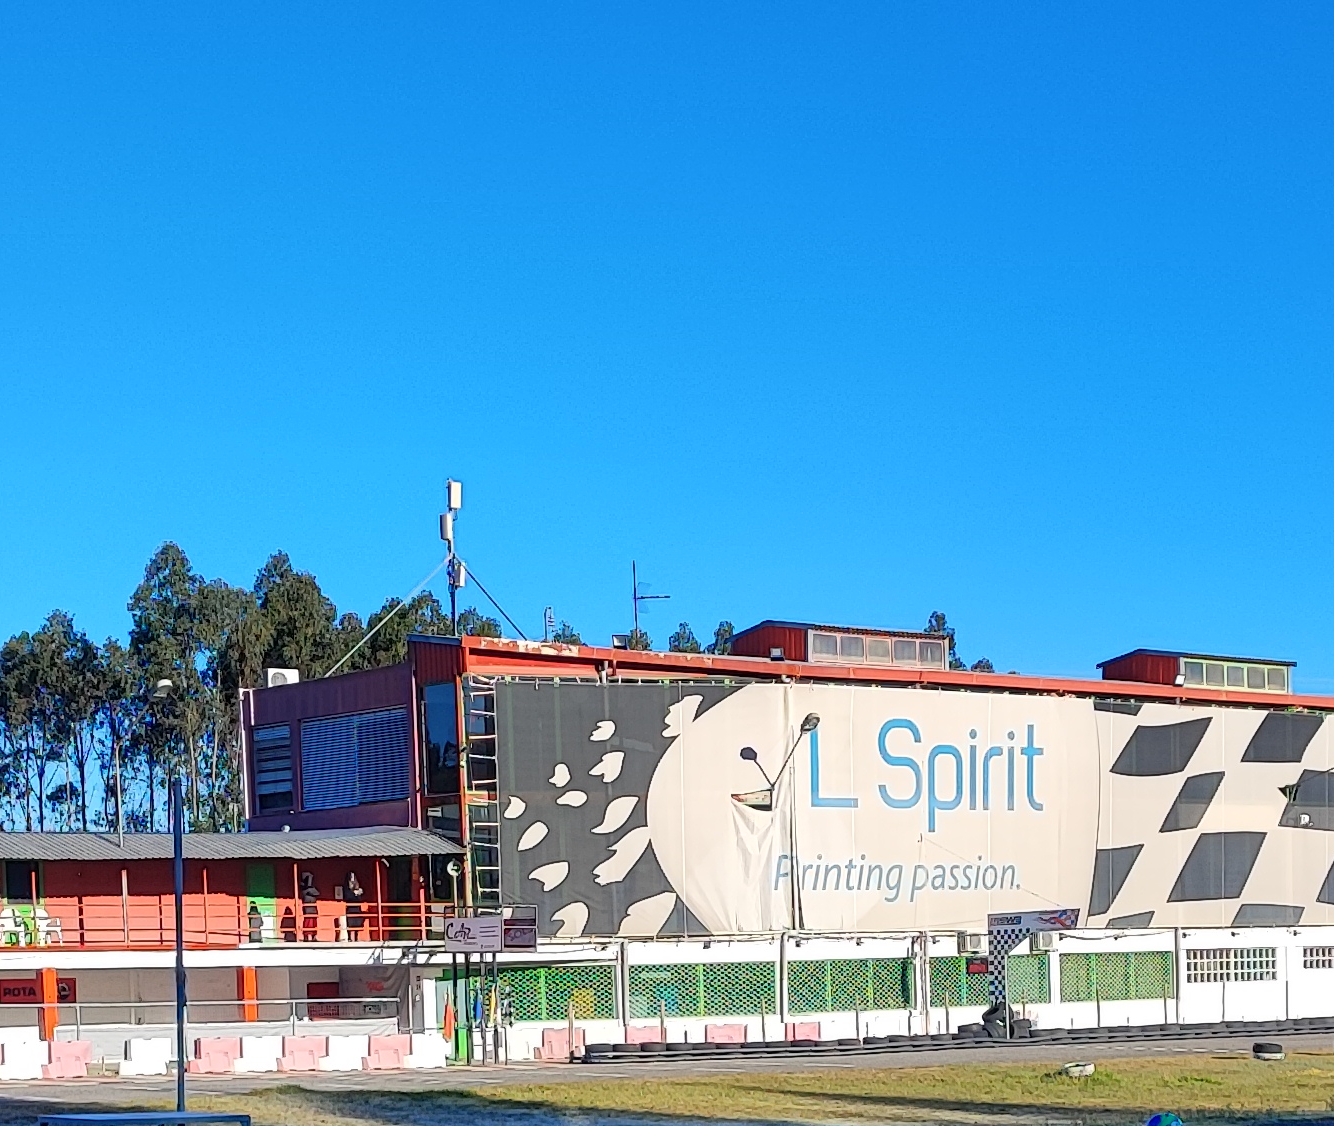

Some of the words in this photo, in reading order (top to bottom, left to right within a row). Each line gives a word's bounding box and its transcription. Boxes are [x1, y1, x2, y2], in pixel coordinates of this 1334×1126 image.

[809, 727, 859, 809] L
[877, 717, 1045, 833] Spirit
[773, 853, 904, 903] Printing
[909, 854, 1021, 903] passion.
[2, 986, 38, 997] ROTA
